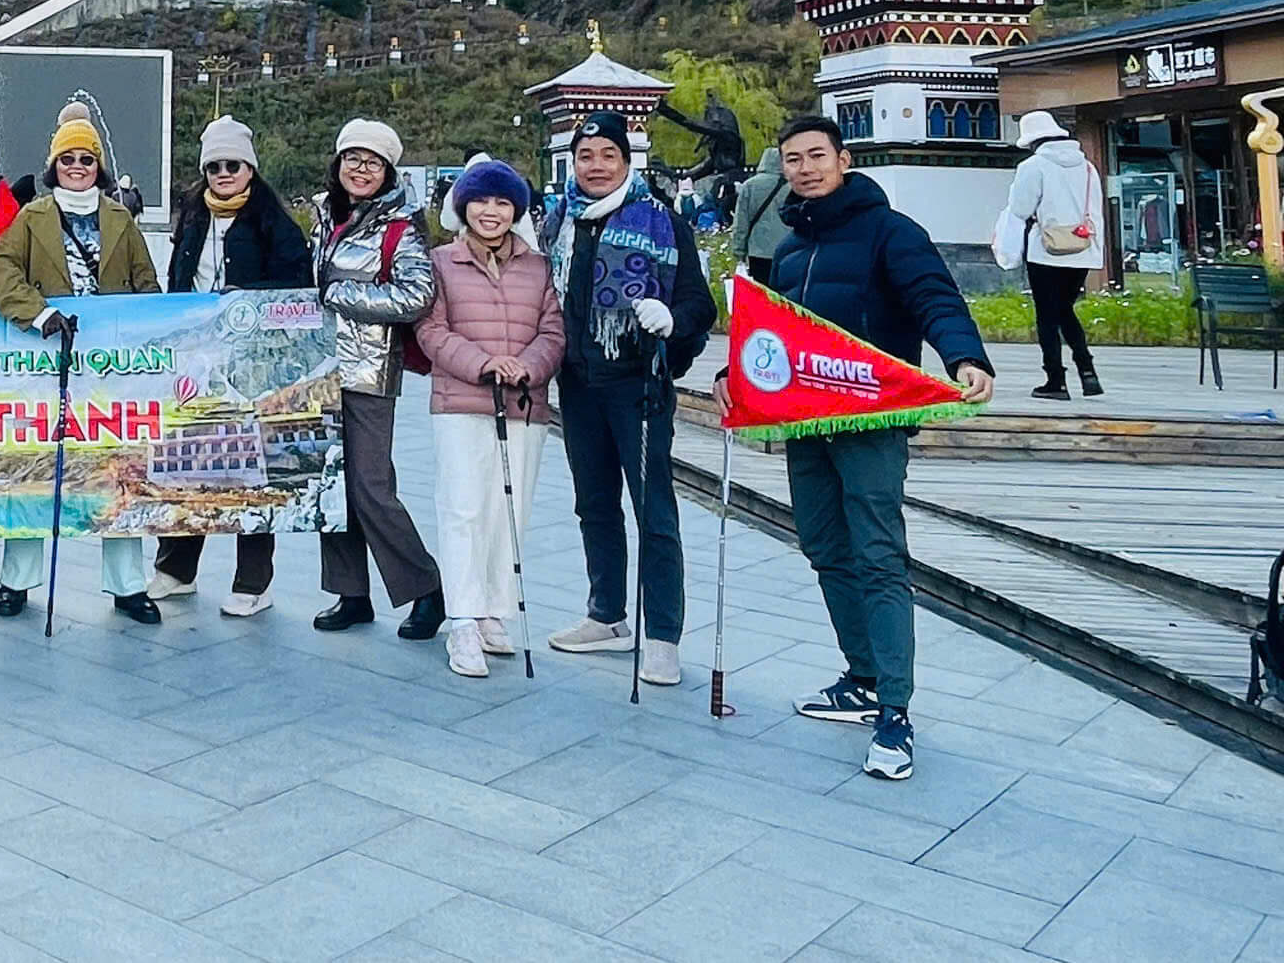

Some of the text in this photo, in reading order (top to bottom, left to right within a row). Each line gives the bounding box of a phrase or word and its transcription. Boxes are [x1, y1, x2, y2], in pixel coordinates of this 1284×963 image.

[268, 303, 317, 317] TRAVEL
[85, 348, 174, 377] QUAN
[795, 351, 880, 385] J TRAVEL
